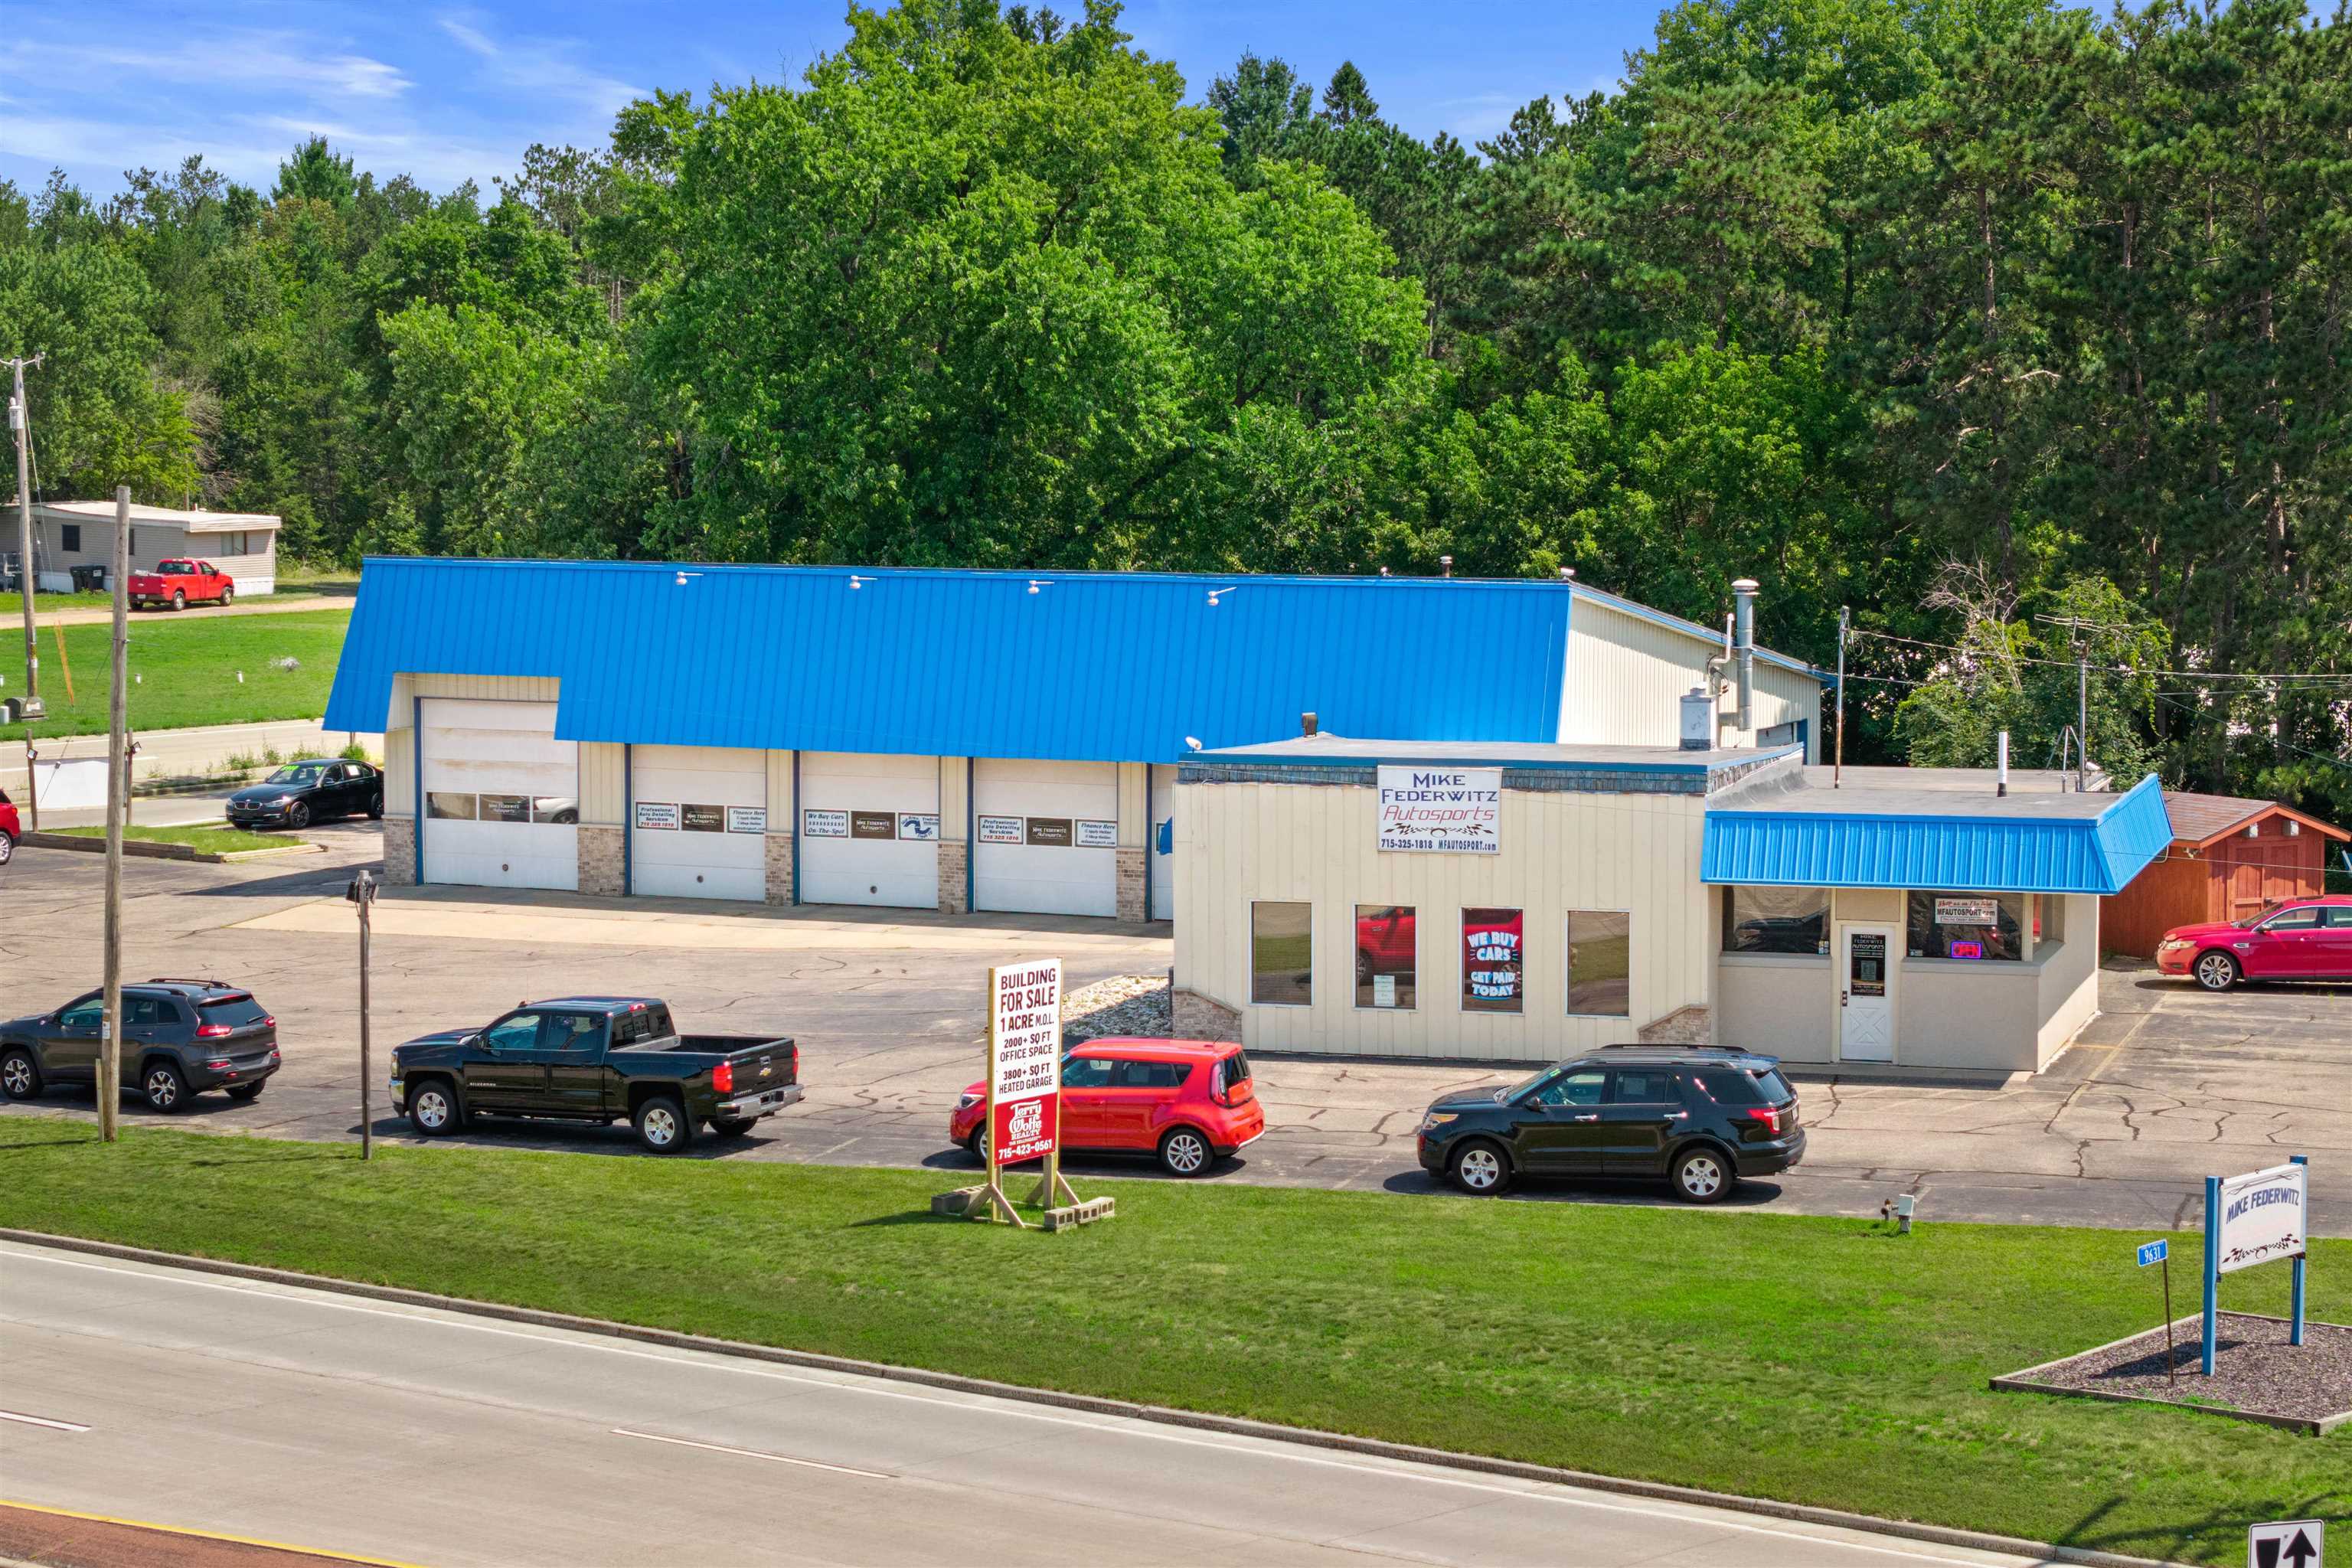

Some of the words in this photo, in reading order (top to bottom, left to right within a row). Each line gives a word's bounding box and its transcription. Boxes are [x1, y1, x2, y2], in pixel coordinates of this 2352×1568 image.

[1413, 773, 1465, 788] MIKE
[1381, 789, 1498, 803] FEDERWITZ
[1383, 805, 1495, 824] Autosports
[1381, 838, 1432, 849] 715-325-1818
[1438, 839, 1496, 851] MFAUTOSPORT.com
[1467, 932, 1491, 948] WE
[1491, 931, 1519, 948] BUY
[1476, 946, 1511, 961] CARS
[1001, 968, 1056, 990] BUILDING
[1470, 971, 1492, 983] GET
[1492, 972, 1516, 984] PAID
[1472, 983, 1514, 996] TODAY
[1001, 991, 1023, 1013] FOR
[1026, 985, 1055, 1009] SALE
[1001, 1017, 1005, 1032] 1
[1008, 1013, 1034, 1031] ACRE
[1036, 1012, 1054, 1027] M.O.L.
[1004, 1037, 1027, 1049] 2000+
[1030, 1033, 1040, 1044] SQ
[1042, 1031, 1051, 1042] FT
[1000, 1048, 1027, 1062] OFFICE
[1029, 1044, 1053, 1057] SPACE
[1003, 1068, 1027, 1080] 3800+
[1029, 1064, 1040, 1076] SQ
[1041, 1063, 1050, 1073] FT
[999, 1080, 1024, 1094] HEATED
[1026, 1075, 1053, 1089] GARAGE
[1011, 1099, 1042, 1116] Terry
[1009, 1114, 1042, 1134] Wolfe
[1011, 1129, 1041, 1140] REALTY
[998, 1138, 1053, 1160] 715-423-0561
[2226, 1195, 2249, 1225] MIKE
[2251, 1187, 2300, 1209] FEDERWITZ
[2145, 1246, 2161, 1263] 9631
